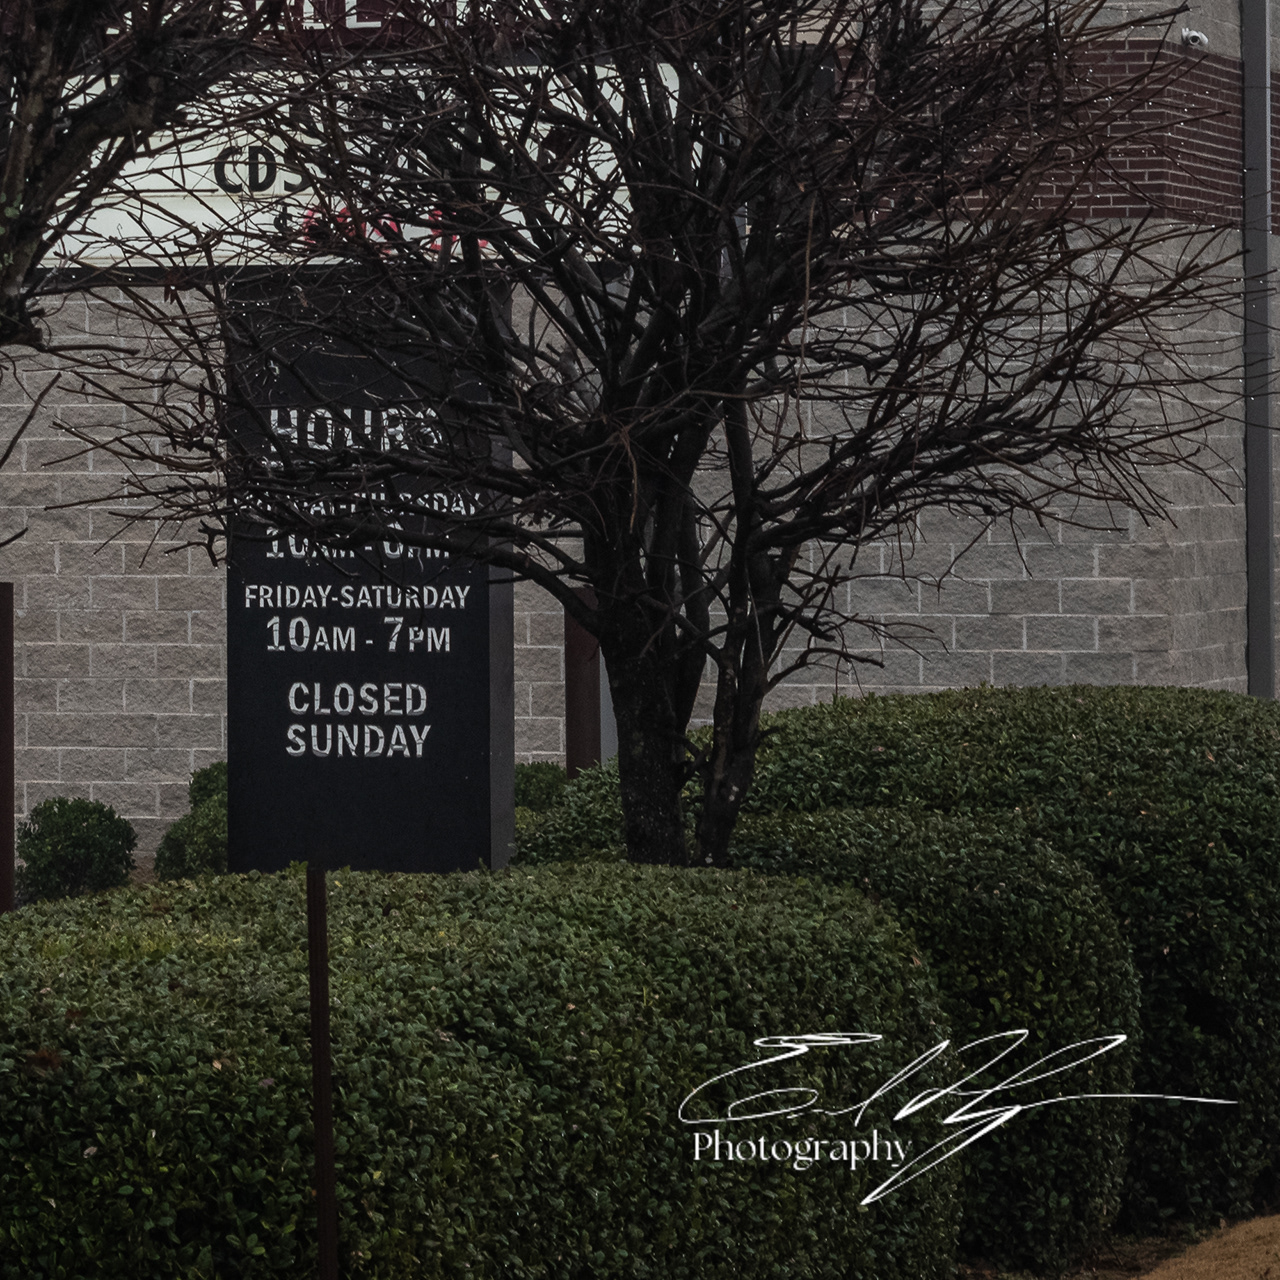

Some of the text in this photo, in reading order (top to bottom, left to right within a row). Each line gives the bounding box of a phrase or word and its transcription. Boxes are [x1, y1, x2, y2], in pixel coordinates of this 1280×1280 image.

[244, 584, 470, 609] FRIDAY-SATURDAY
[266, 616, 355, 652] 10AM
[384, 616, 451, 652] 7PM
[288, 682, 427, 716] CLOSED
[285, 723, 431, 758] SUNDAY
